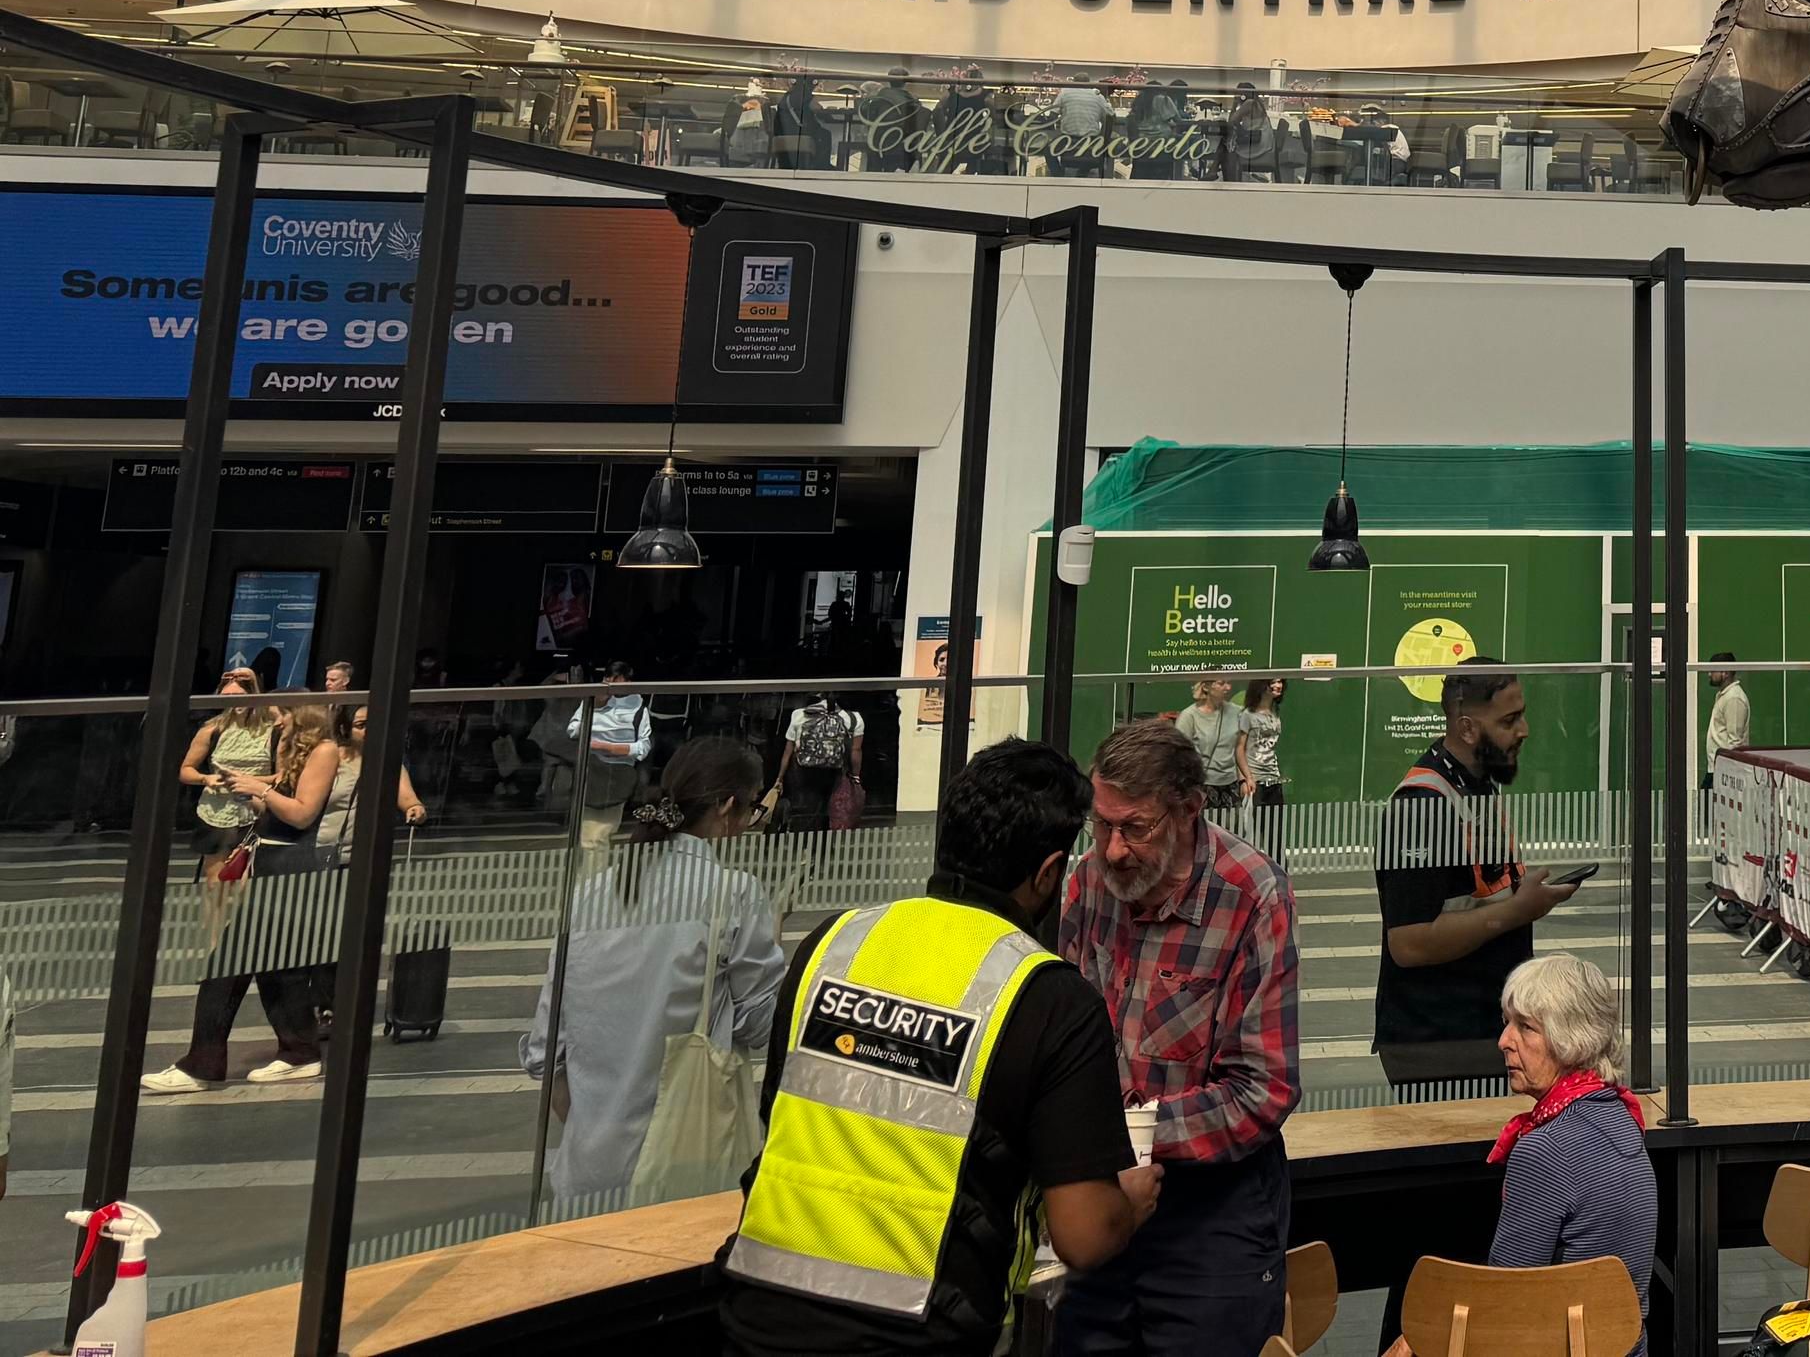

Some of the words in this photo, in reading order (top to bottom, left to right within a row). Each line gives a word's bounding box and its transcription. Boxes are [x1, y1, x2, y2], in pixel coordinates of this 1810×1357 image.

[1005, 101, 1212, 160] Concerto
[263, 215, 385, 243] Coventry
[262, 235, 382, 261] University
[747, 265, 789, 281] TEF
[60, 269, 204, 300] Some
[453, 279, 612, 311] good...
[746, 283, 785, 295] 2023
[749, 306, 777, 315] Gold
[149, 316, 200, 339] w
[241, 317, 328, 340] are
[344, 315, 514, 348] goen
[734, 326, 790, 335] Outstanding
[725, 344, 776, 352] experience
[762, 353, 790, 361] rating
[262, 371, 338, 393] Apply
[344, 377, 400, 390] now
[150, 465, 181, 476] Platfo
[229, 466, 246, 476] 12b
[248, 466, 268, 476] and
[269, 467, 283, 476] 4c
[716, 471, 726, 480] to
[727, 470, 740, 480] 5a
[692, 485, 717, 495] class
[719, 485, 752, 496] lounge
[1174, 585, 1232, 609] Hello
[1422, 591, 1460, 599] meantime
[1403, 602, 1422, 610] your
[1165, 610, 1239, 633] Better
[1166, 639, 1178, 647] Say
[1160, 664, 1179, 673] your
[1391, 714, 1432, 723] Birmingham
[818, 986, 967, 1047] SECURITY
[855, 1041, 920, 1069] amberstone
